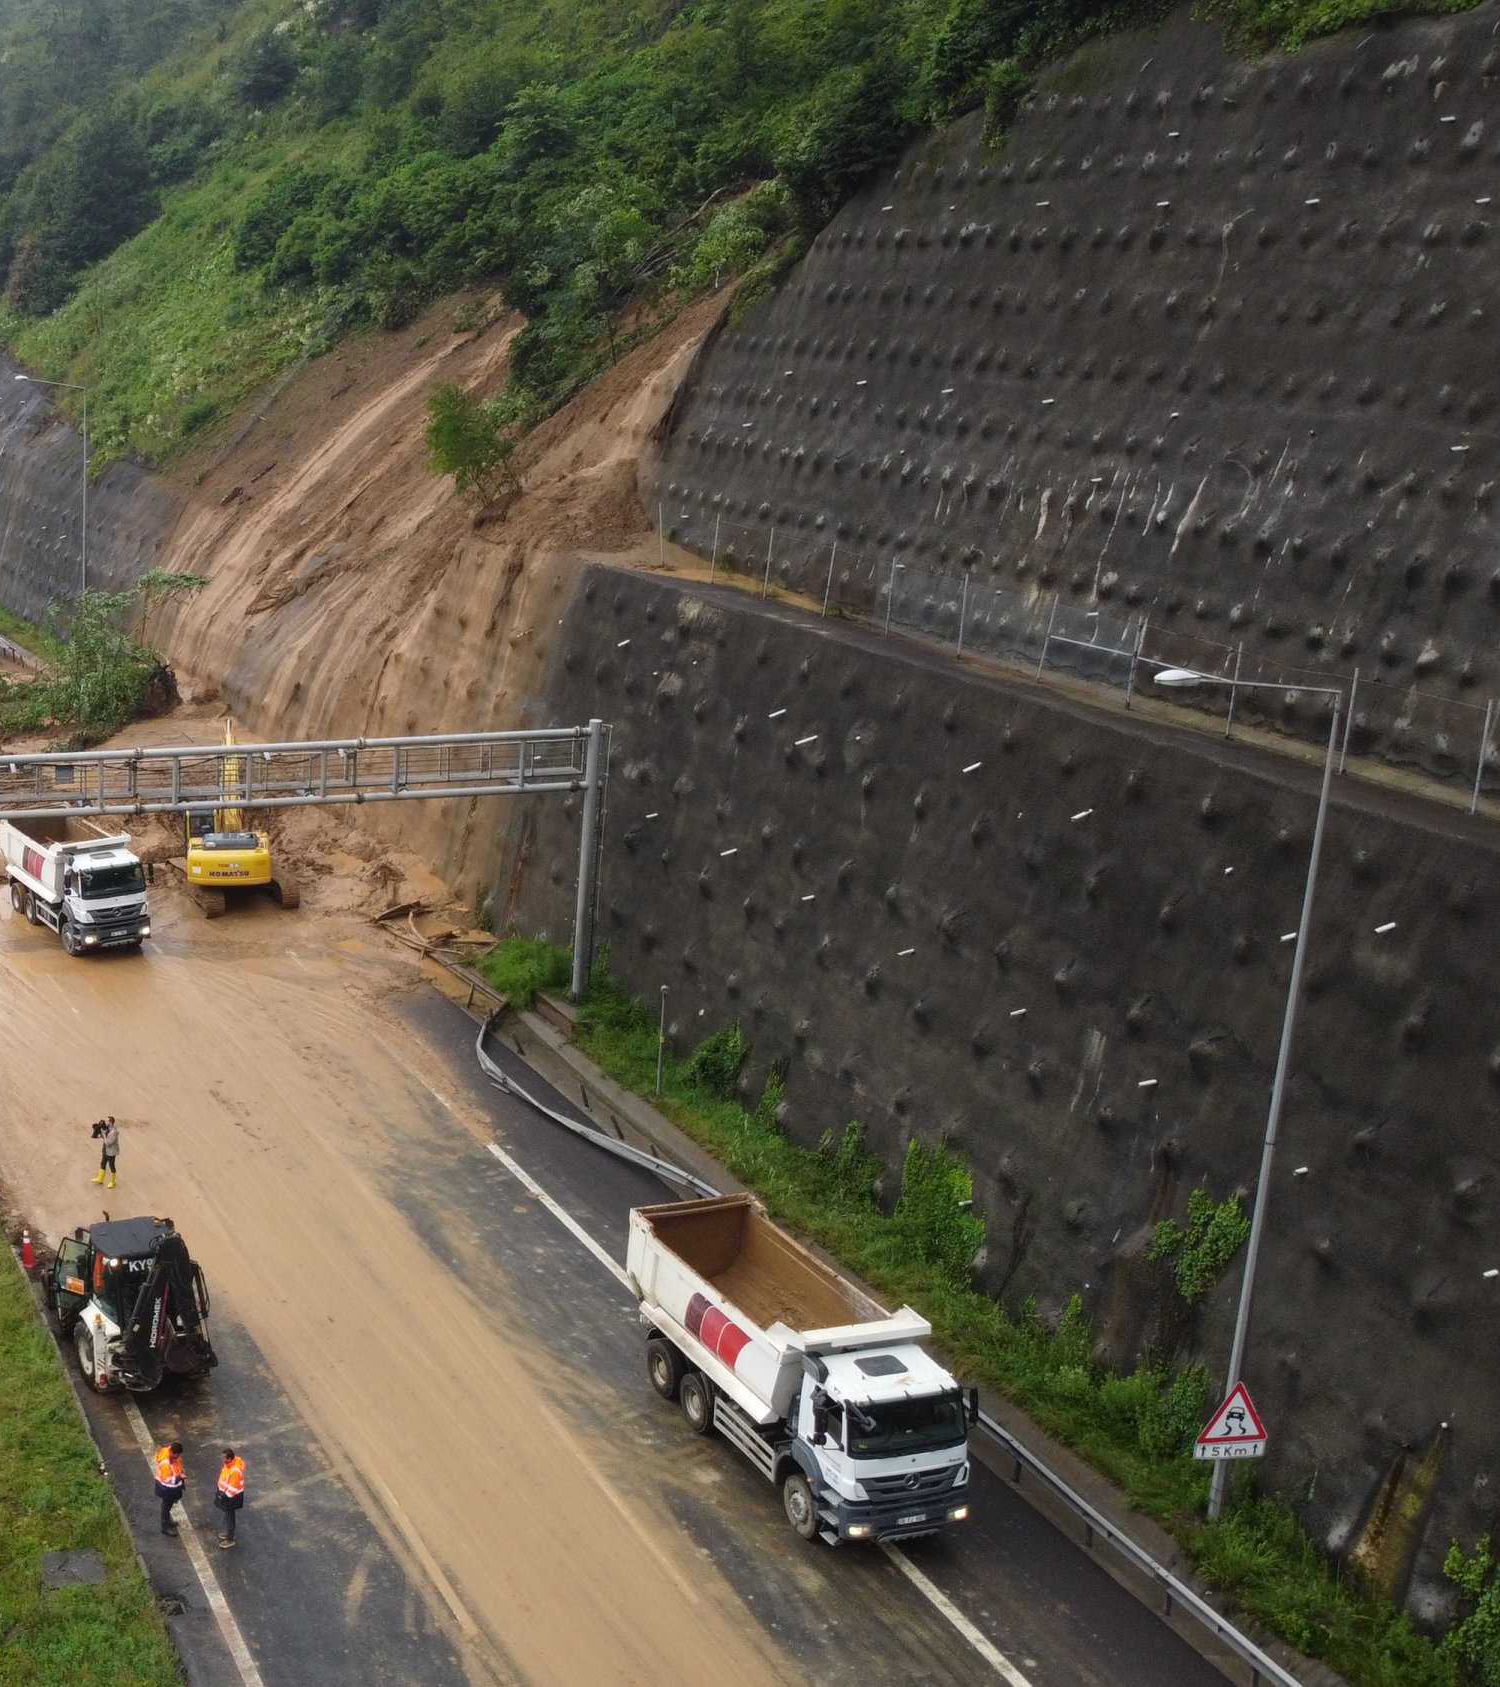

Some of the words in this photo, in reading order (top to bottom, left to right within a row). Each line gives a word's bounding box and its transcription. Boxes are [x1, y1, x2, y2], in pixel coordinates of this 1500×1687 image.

[149, 1297, 162, 1349] HIDROMEK
[1211, 1446, 1220, 1456] 5
[1223, 1446, 1247, 1456] Km
